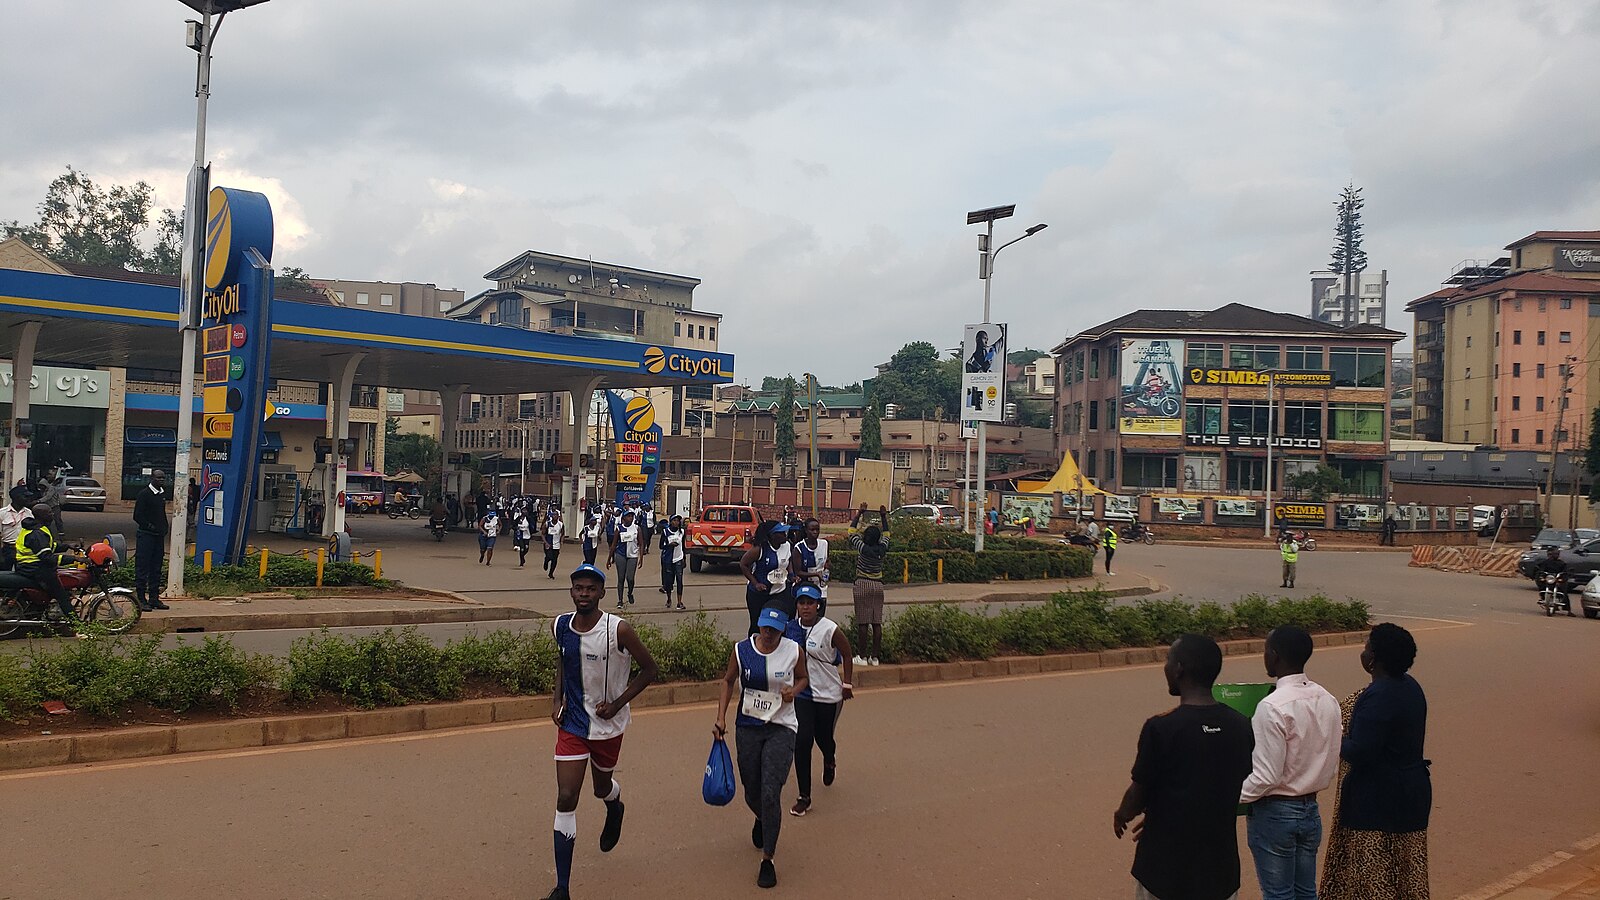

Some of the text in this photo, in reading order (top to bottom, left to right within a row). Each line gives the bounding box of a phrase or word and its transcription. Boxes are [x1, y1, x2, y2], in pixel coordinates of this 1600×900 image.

[203, 283, 240, 323] CityOil
[668, 353, 721, 377] CityOil
[1206, 370, 1271, 385] SIMBA
[275, 406, 291, 415] GO
[624, 430, 658, 444] CityOil
[1187, 434, 1321, 448] THE STUDIO
[1286, 505, 1325, 514] SIMBA
[753, 698, 773, 711] 13157
